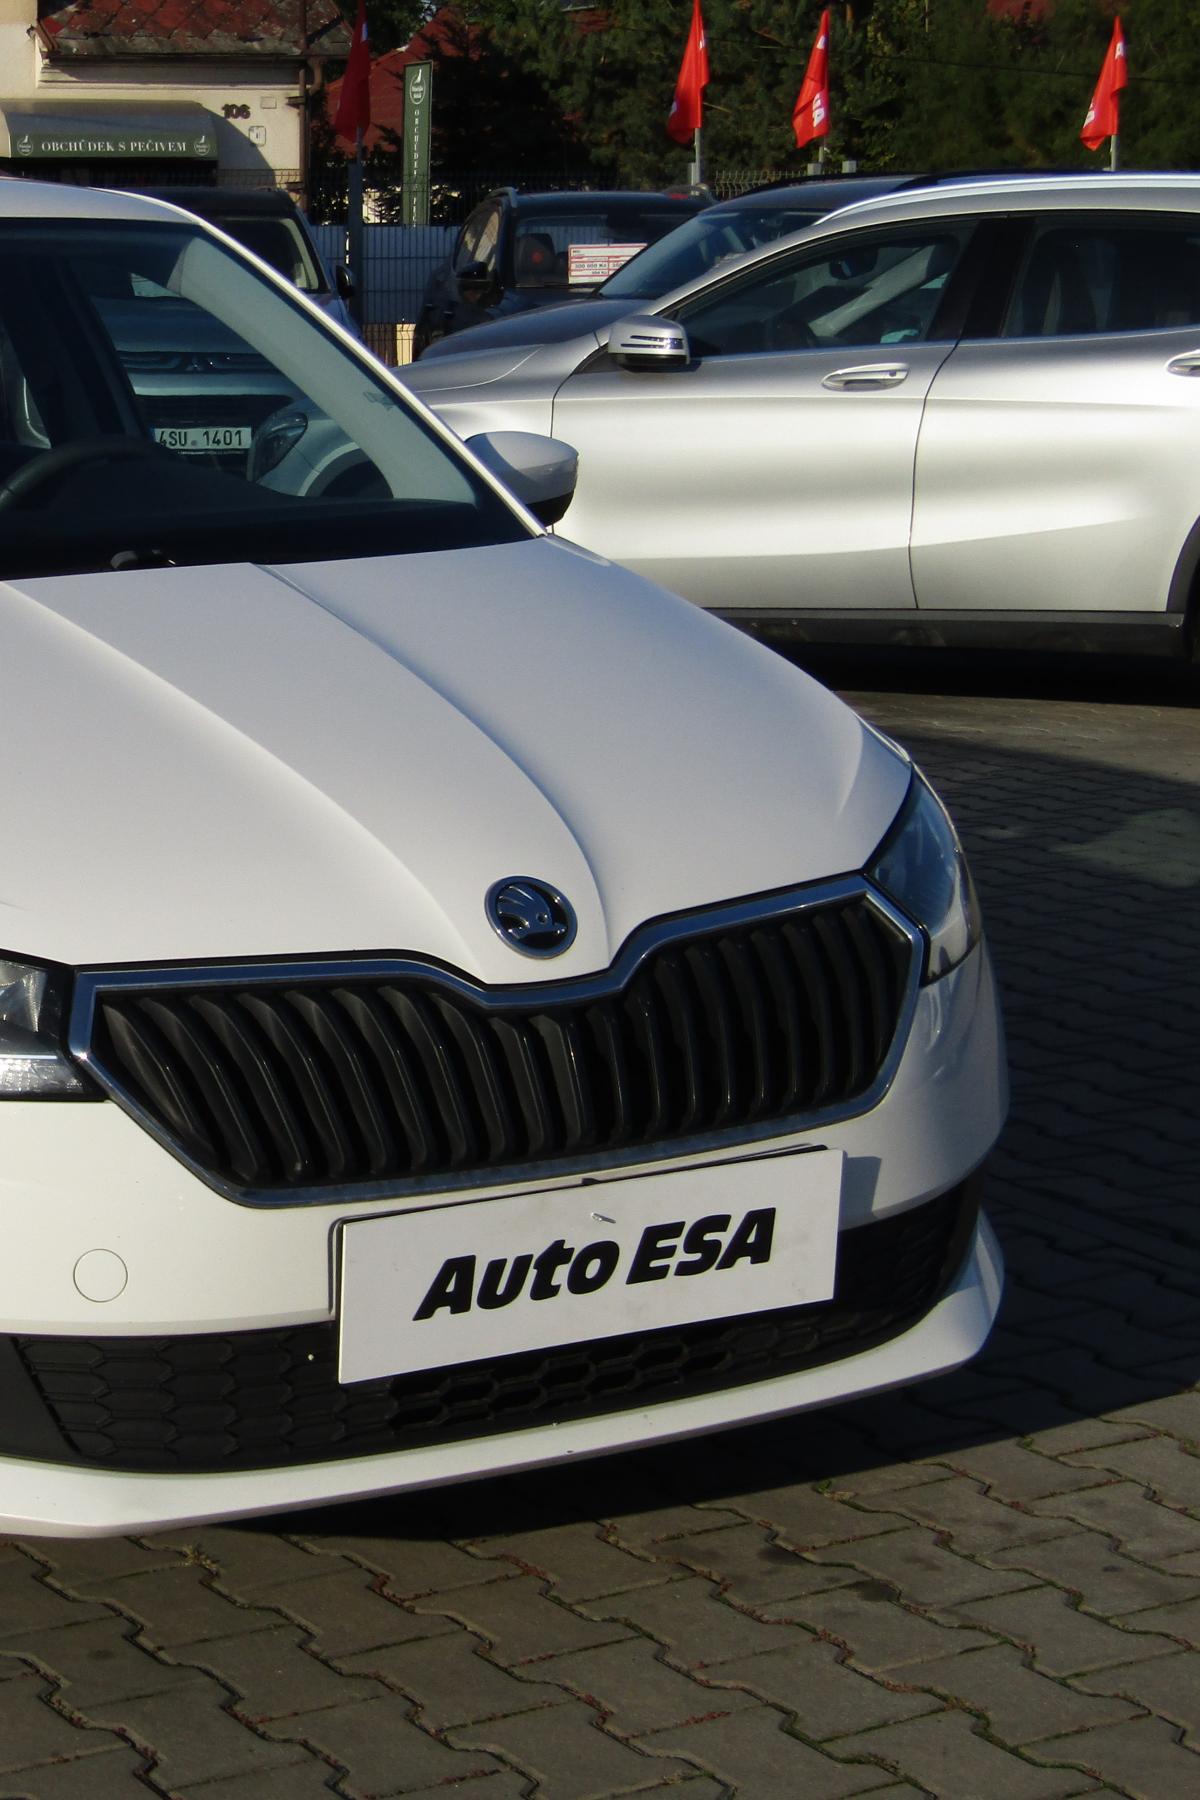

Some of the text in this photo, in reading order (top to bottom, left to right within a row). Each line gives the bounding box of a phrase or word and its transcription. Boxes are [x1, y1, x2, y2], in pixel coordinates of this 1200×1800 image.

[221, 104, 250, 119] 106
[41, 139, 115, 152] OBCHŮDEK
[118, 141, 126, 152] S
[130, 140, 187, 153] PEČIVEM
[160, 430, 242, 447] 4SU 1401
[412, 1207, 776, 1321] Auto ESA
